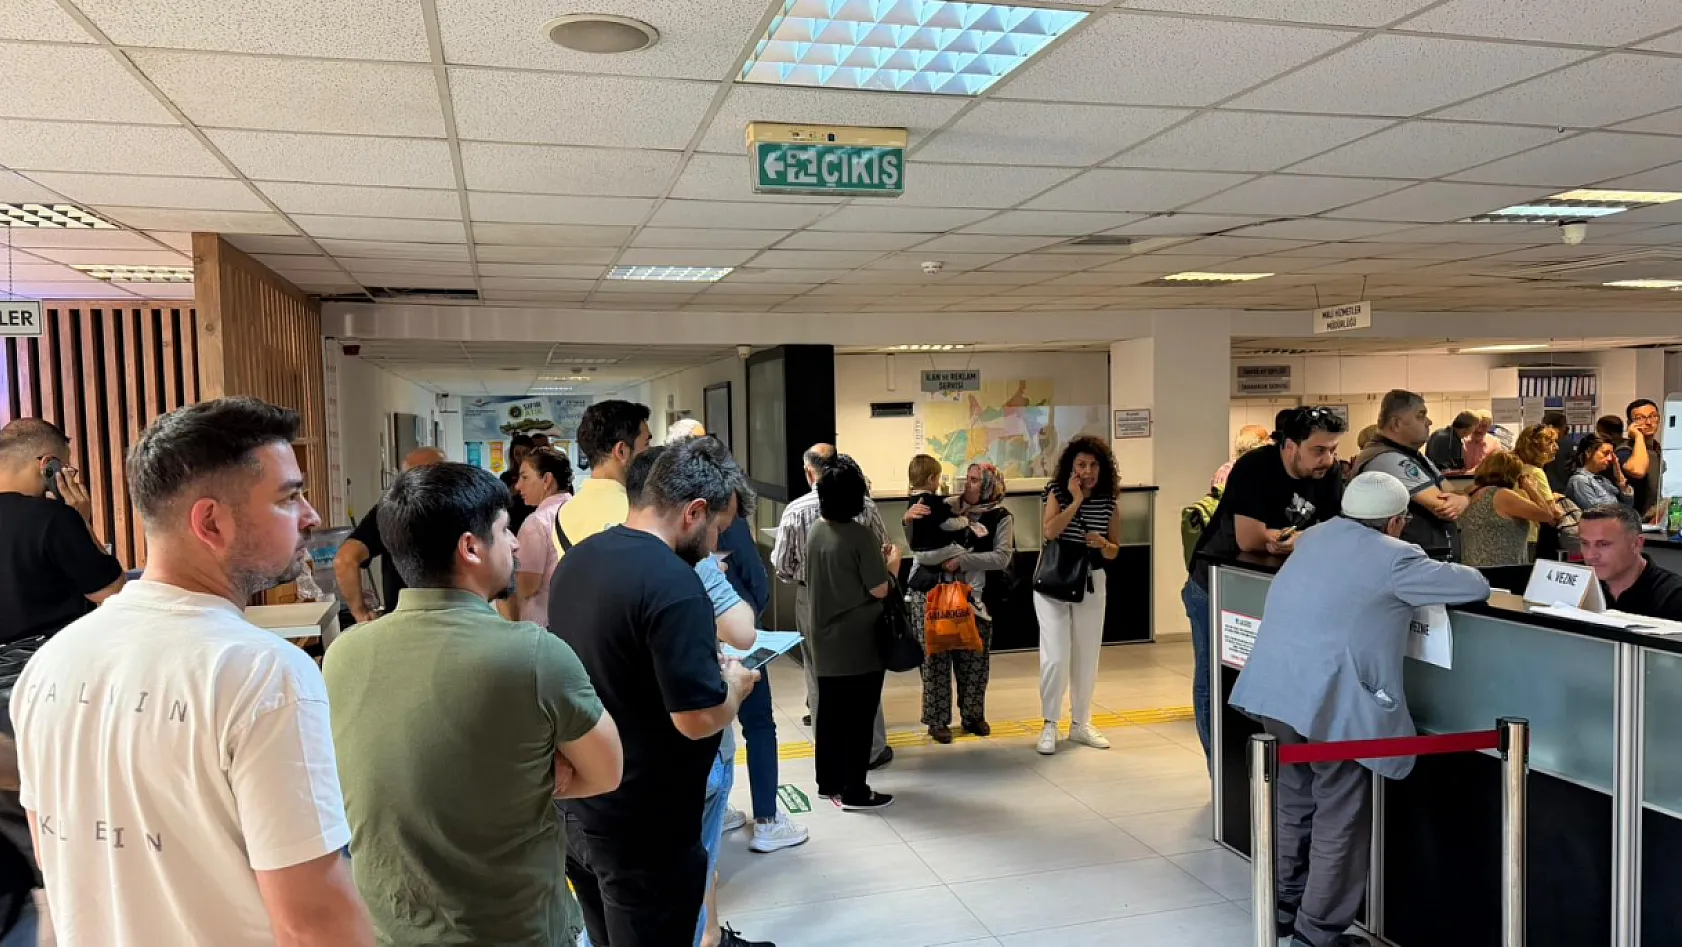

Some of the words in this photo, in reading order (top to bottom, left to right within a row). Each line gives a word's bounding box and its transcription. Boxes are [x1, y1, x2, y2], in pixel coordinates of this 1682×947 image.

[821, 152, 899, 188] ÇIKIŞ
[0, 310, 34, 326] LER
[1555, 570, 1579, 586] VEZNE
[39, 815, 163, 852] KLEIN
